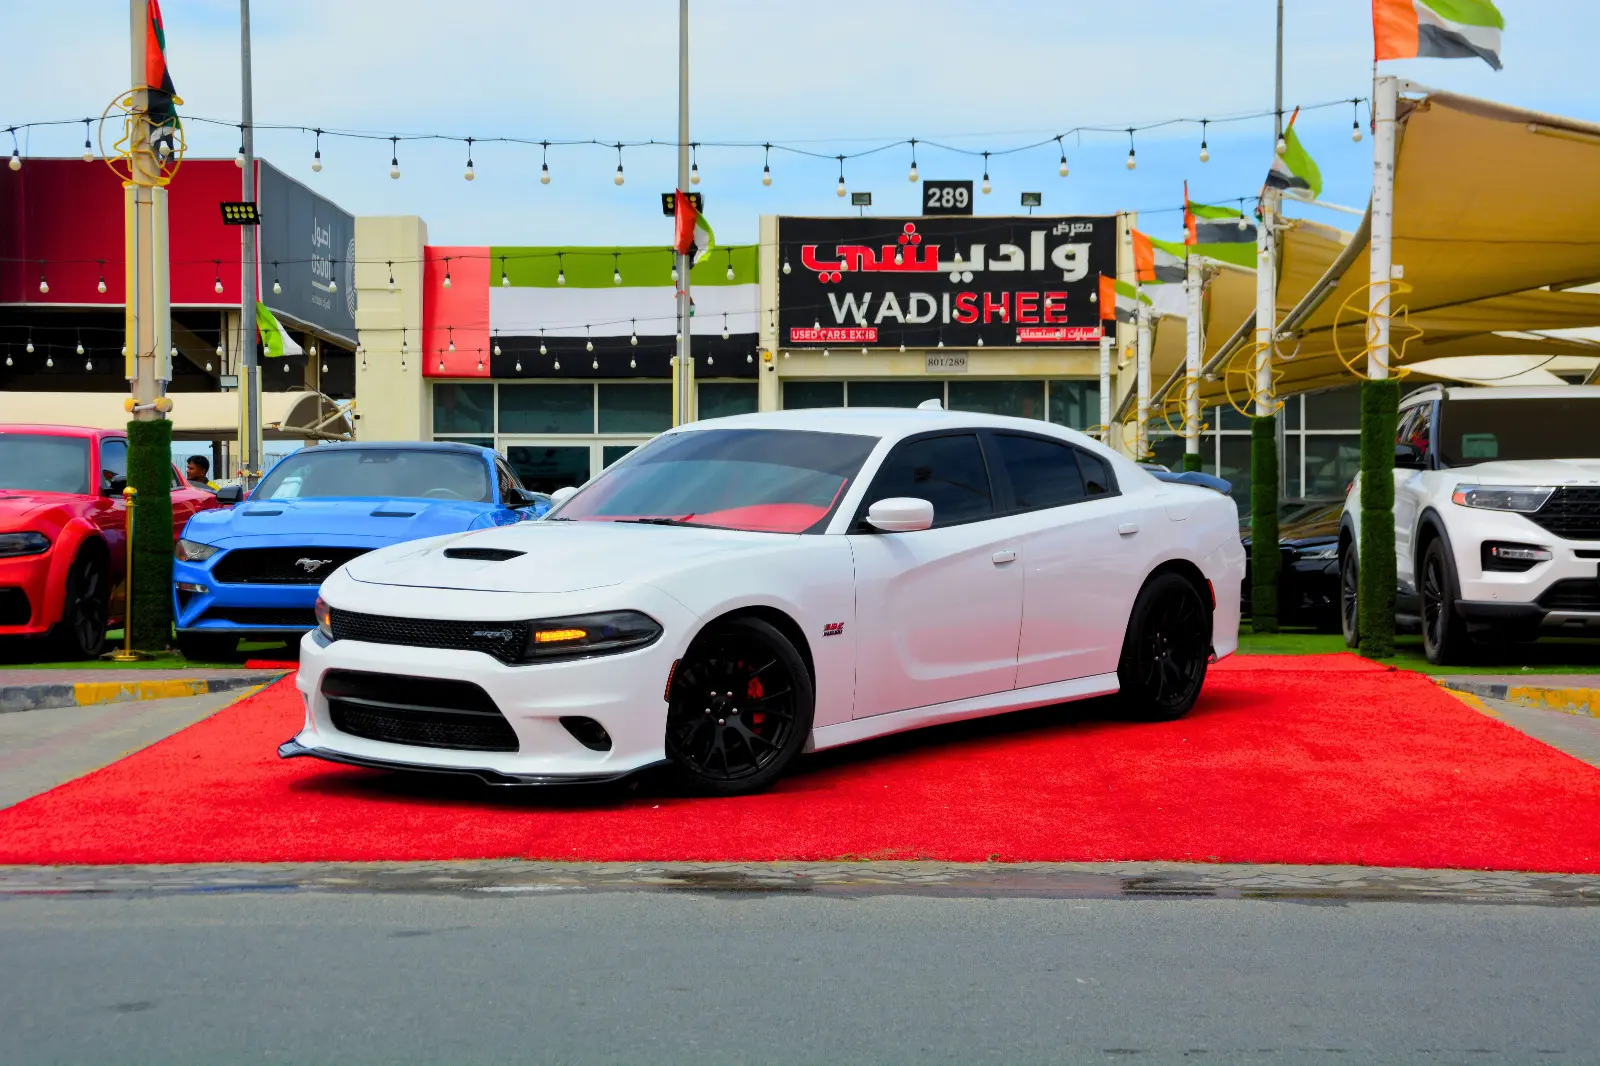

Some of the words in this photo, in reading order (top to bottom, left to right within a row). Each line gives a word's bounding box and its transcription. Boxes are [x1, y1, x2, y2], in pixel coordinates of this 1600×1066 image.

[927, 187, 969, 208] 289
[1052, 221, 1093, 236] معرض
[792, 330, 818, 339] USED
[820, 330, 847, 339] CARS
[927, 358, 965, 366] 801/289
